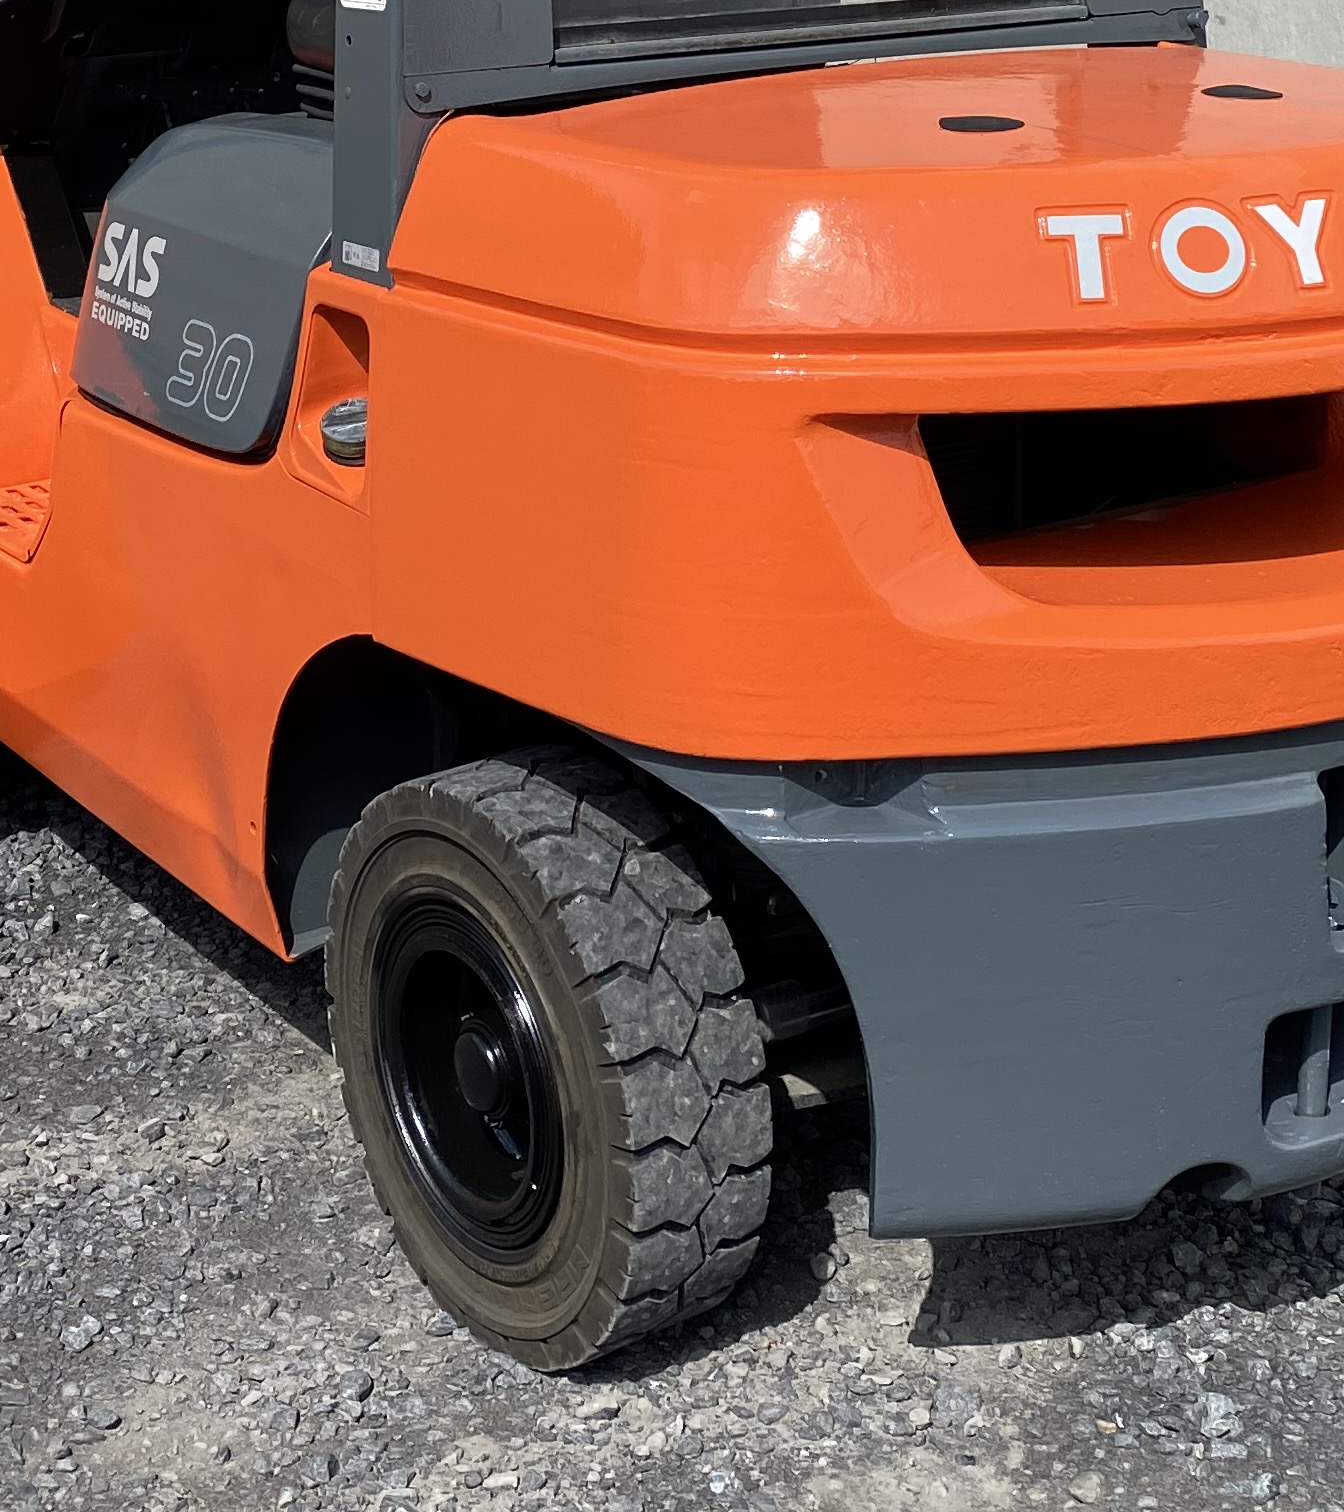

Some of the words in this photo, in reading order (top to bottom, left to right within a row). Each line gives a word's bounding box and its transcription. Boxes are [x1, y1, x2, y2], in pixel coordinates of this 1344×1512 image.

[97, 221, 167, 298] SAS
[91, 301, 150, 341] EQUIPPED
[166, 319, 254, 422] 30
